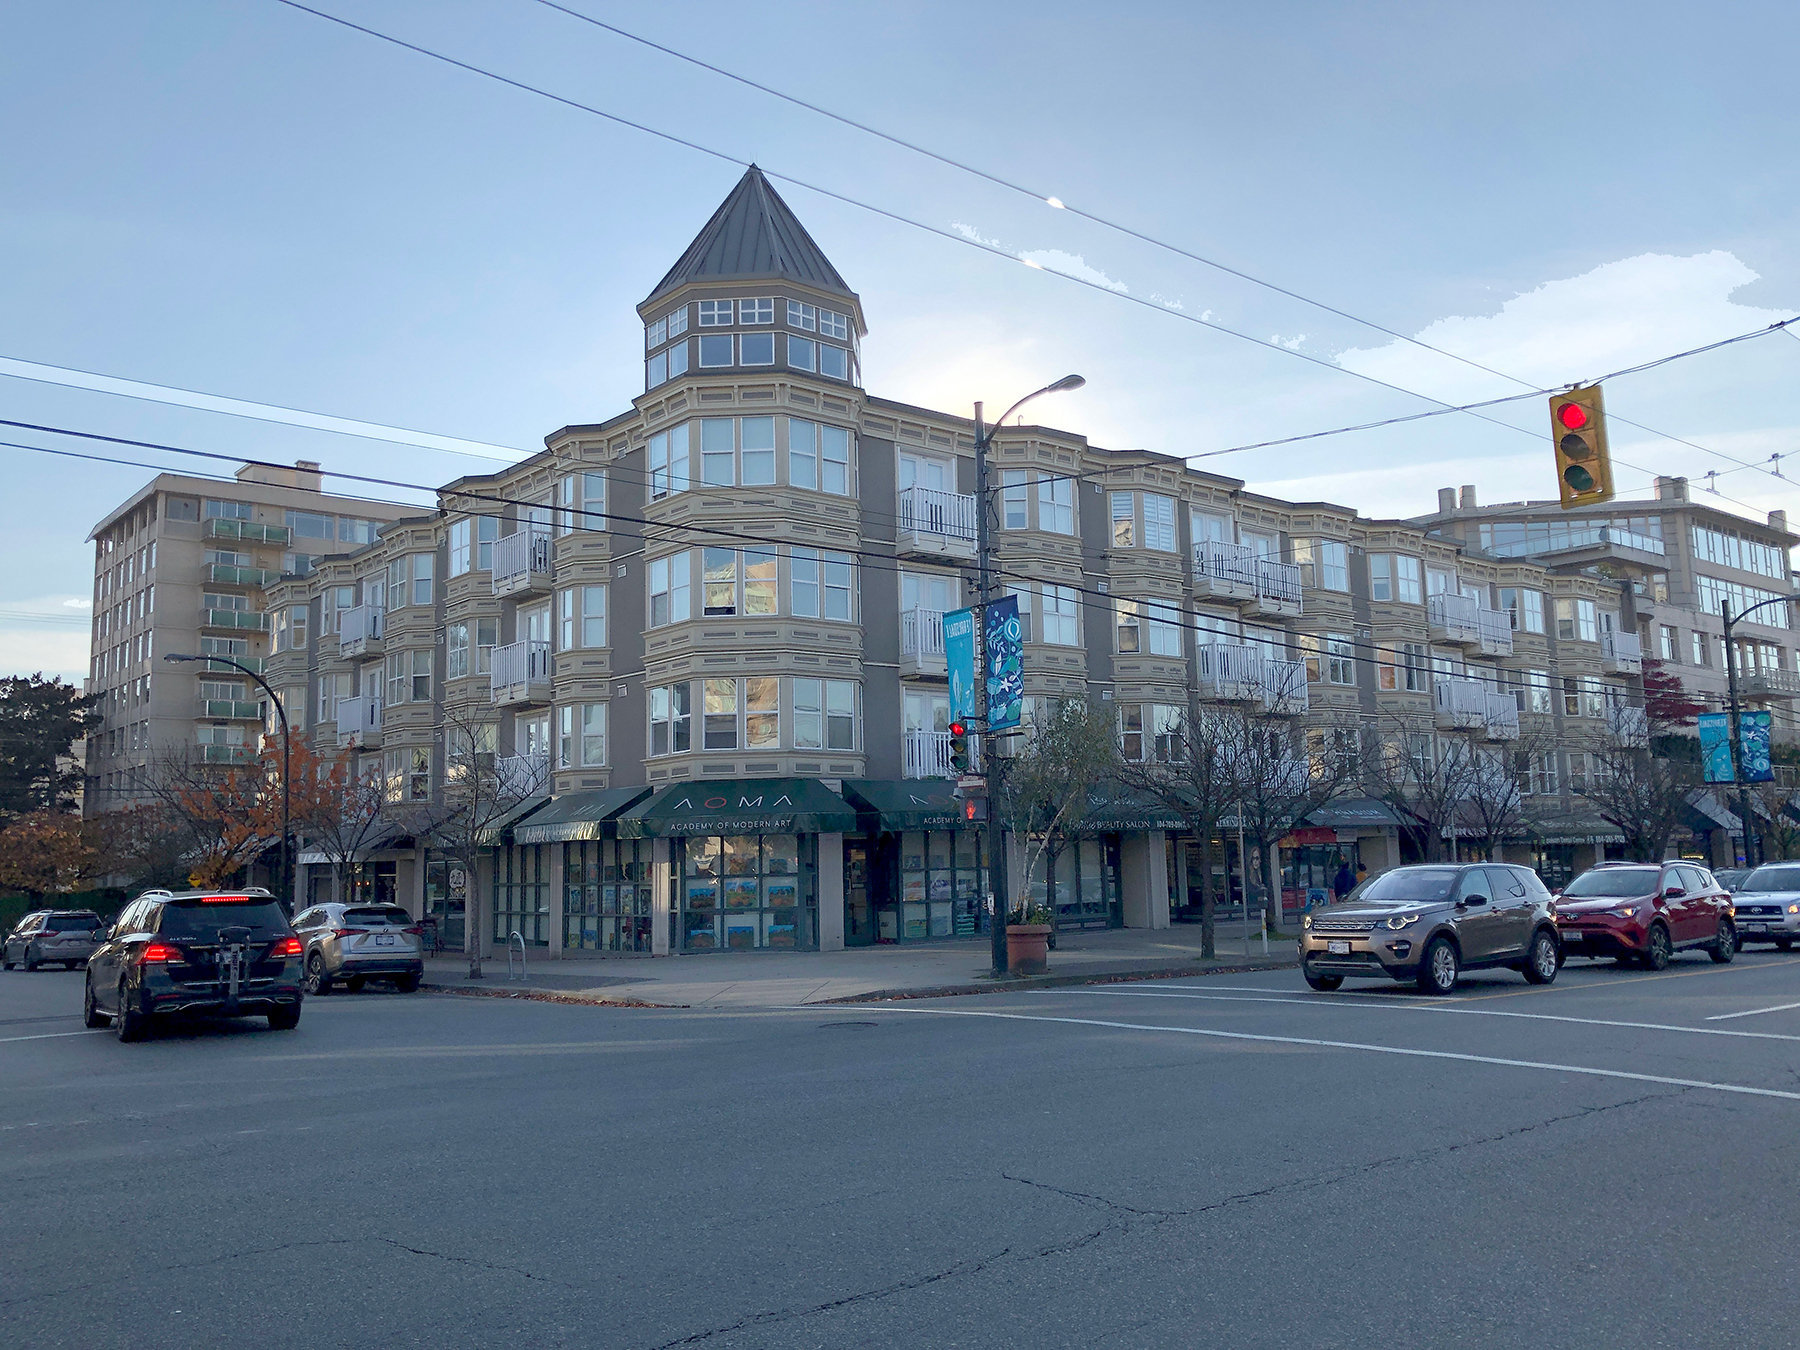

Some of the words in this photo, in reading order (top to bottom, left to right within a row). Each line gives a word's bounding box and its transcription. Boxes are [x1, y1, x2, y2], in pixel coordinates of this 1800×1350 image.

[671, 822, 714, 831] ACADEMY
[717, 821, 729, 829] OF
[733, 820, 771, 829] MODERN
[774, 819, 791, 828] ART
[923, 817, 955, 825] ACADEMY
[1125, 820, 1151, 829] SALON
